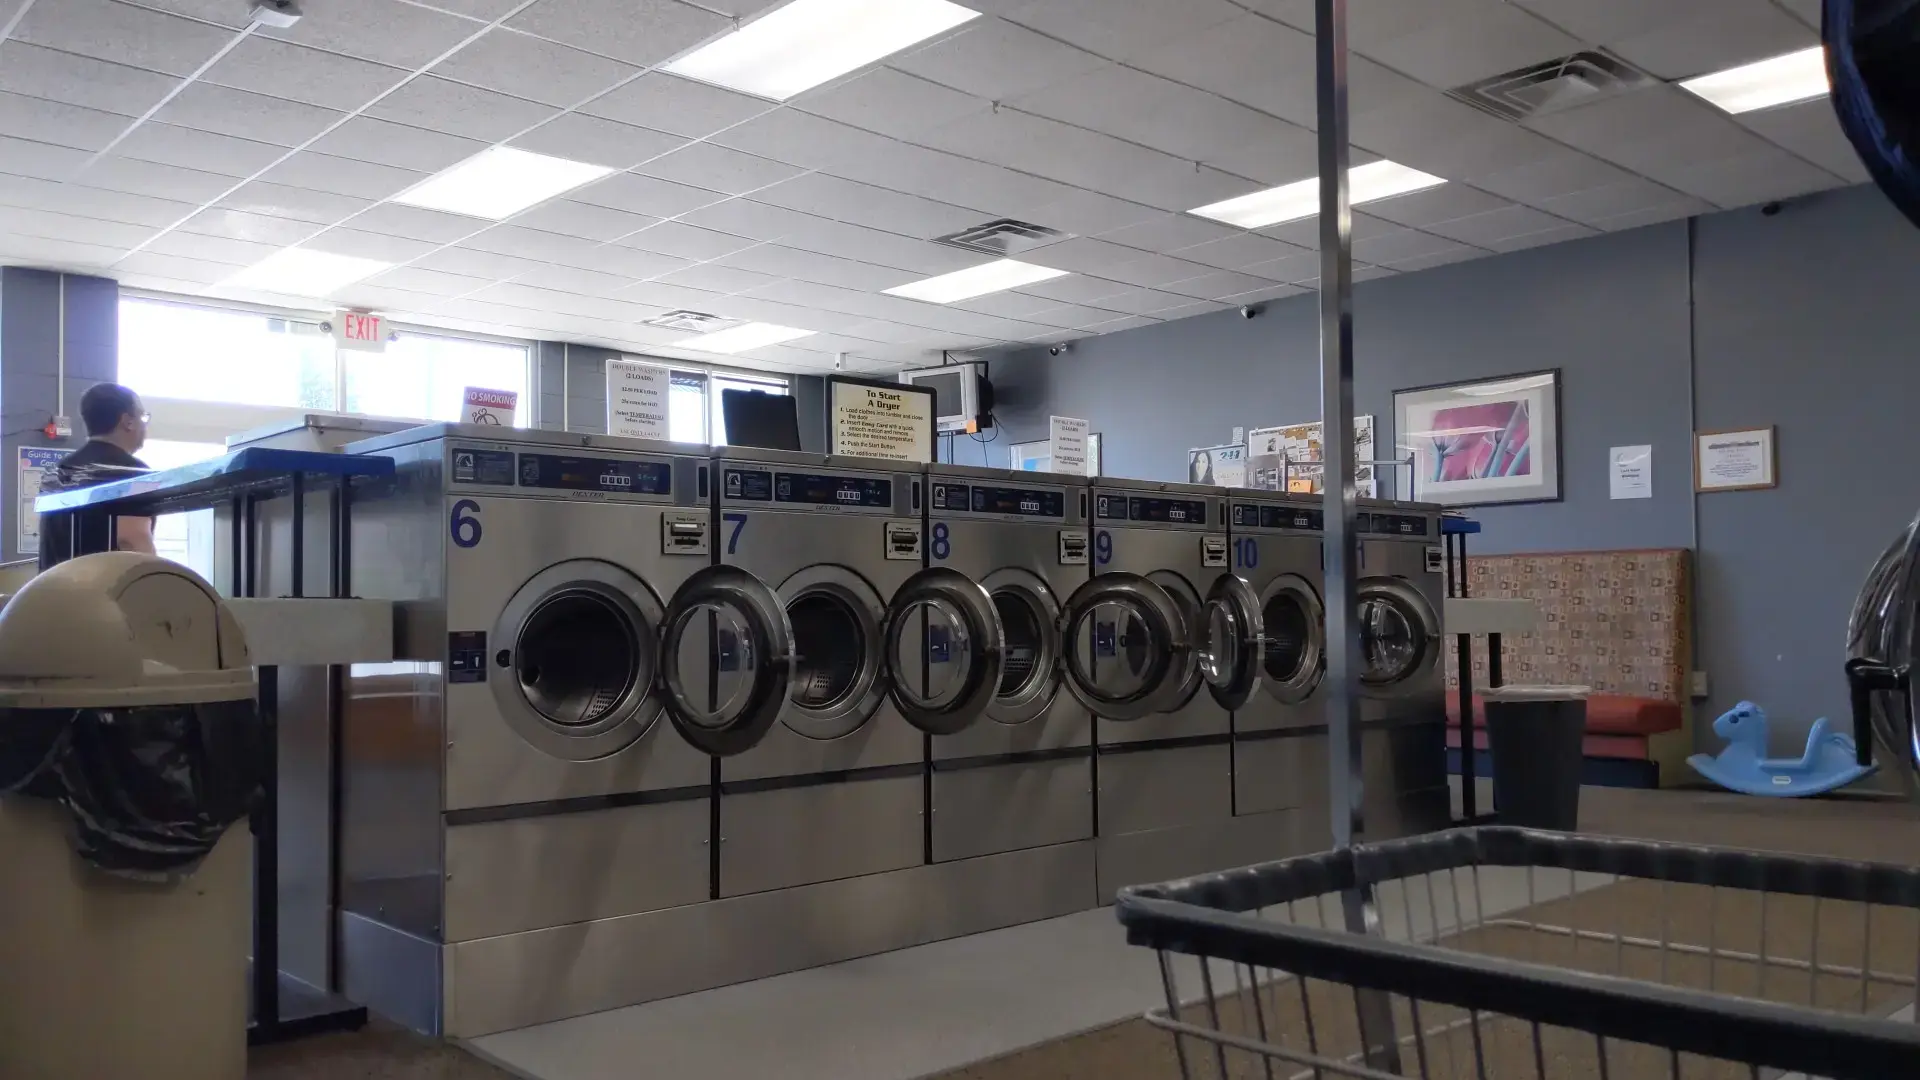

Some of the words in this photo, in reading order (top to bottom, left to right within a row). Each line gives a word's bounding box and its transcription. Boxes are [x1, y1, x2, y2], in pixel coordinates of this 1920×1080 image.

[345, 314, 380, 342] EXIT
[478, 393, 515, 405] SMOKING
[866, 390, 876, 398] To
[879, 391, 901, 401] Start
[877, 401, 900, 410] Dryer
[28, 451, 51, 459] Guide
[451, 499, 482, 548] 6
[723, 514, 748, 554] 7
[931, 522, 950, 560] 8
[1096, 530, 1112, 564] 9
[1234, 537, 1258, 568] 10
